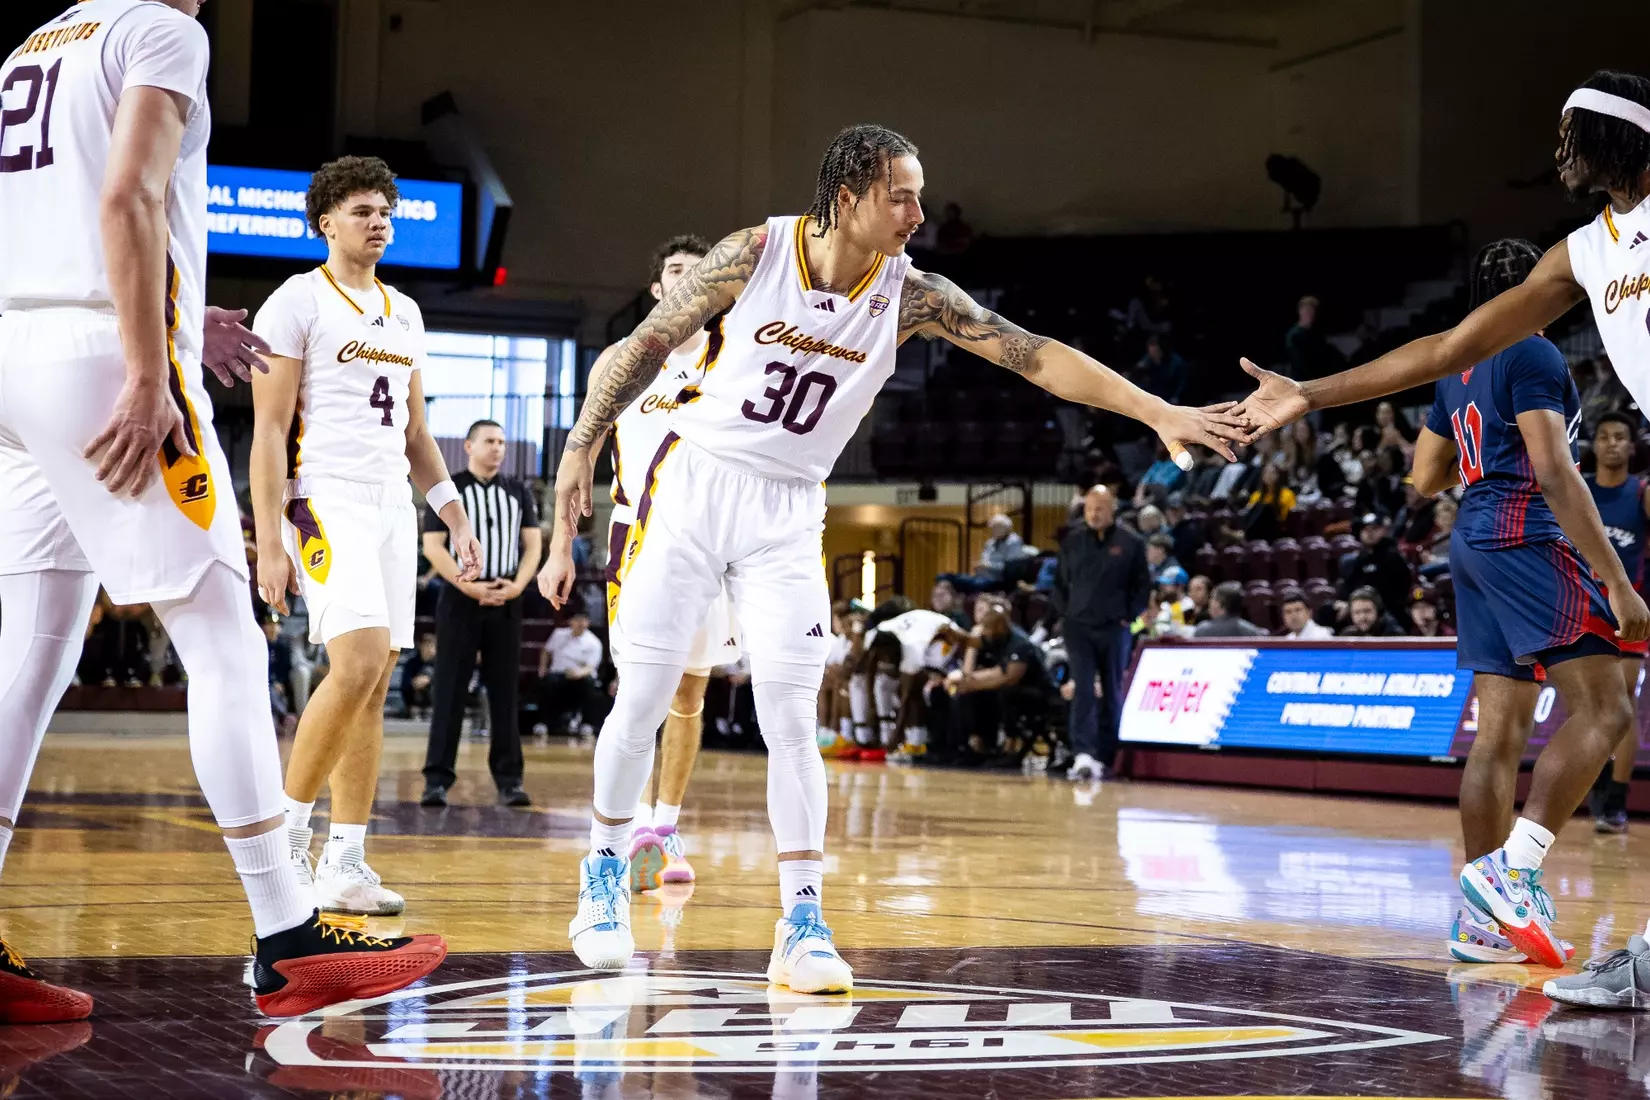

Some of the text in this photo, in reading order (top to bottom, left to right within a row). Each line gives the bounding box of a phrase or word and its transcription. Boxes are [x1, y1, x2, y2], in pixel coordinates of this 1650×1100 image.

[0, 57, 63, 173] 21
[207, 211, 305, 239] REFERRED
[1604, 272, 1650, 315] Chip
[336, 340, 415, 367] Chippewas
[753, 321, 868, 363] Chippewas
[369, 375, 395, 427] 4
[741, 361, 838, 435] 30
[1139, 668, 1210, 725] meijer
[754, 1037, 1005, 1053] 1946
